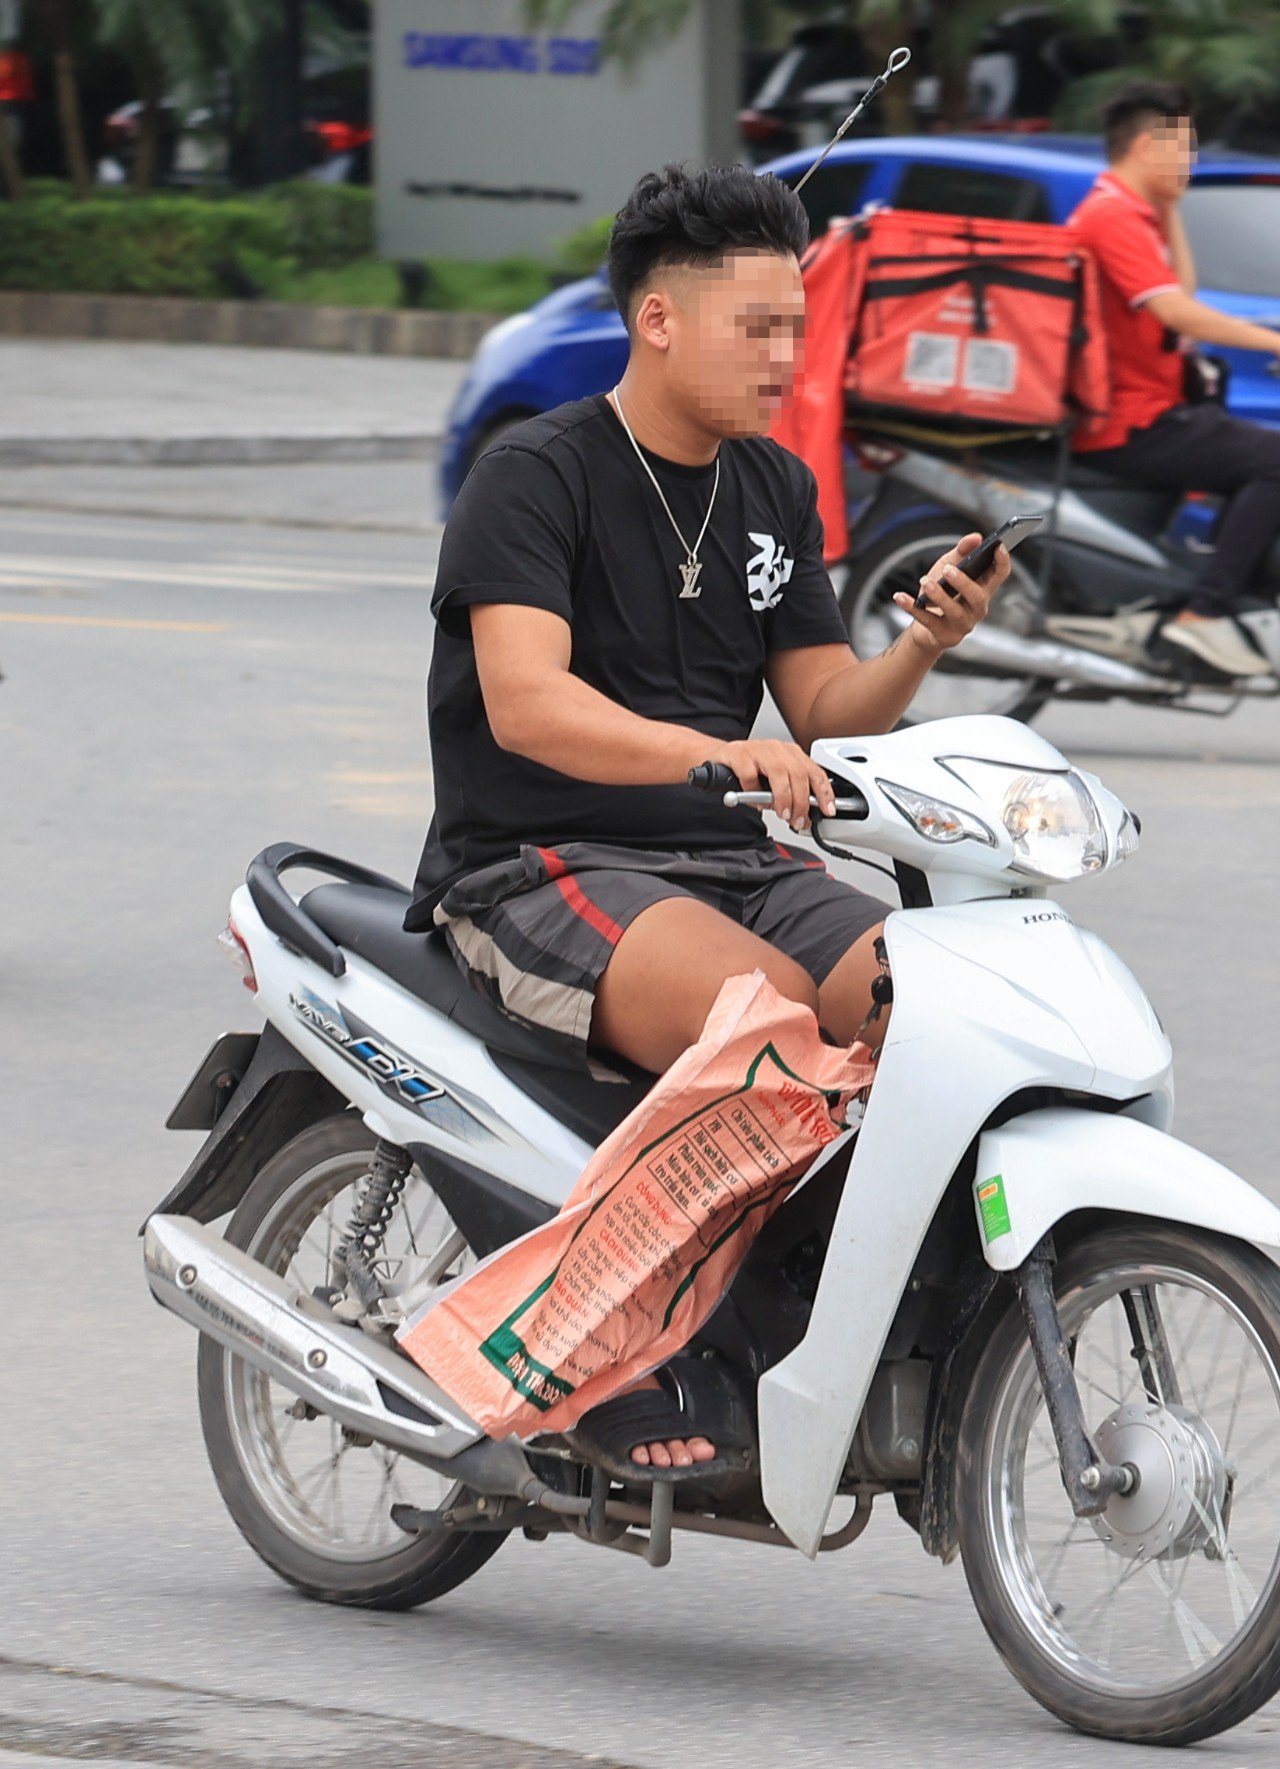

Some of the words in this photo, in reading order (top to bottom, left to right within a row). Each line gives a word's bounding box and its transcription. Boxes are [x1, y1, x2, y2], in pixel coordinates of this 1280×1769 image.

[762, 1149, 782, 1168] tích
[653, 1164, 668, 1179] tro
[725, 1172, 739, 1185] cơ
[634, 1180, 657, 1205] CÔNG
[687, 1184, 700, 1196] cơ
[623, 1195, 642, 1217] Cung
[636, 1212, 652, 1229] cấp
[647, 1223, 663, 1241] các
[597, 1227, 620, 1251] CÁCH
[601, 1212, 617, 1229] hợp
[620, 1233, 641, 1255] nhiều
[575, 1246, 590, 1262] cây
[587, 1238, 606, 1260] Dùng
[578, 1269, 598, 1291] dùng
